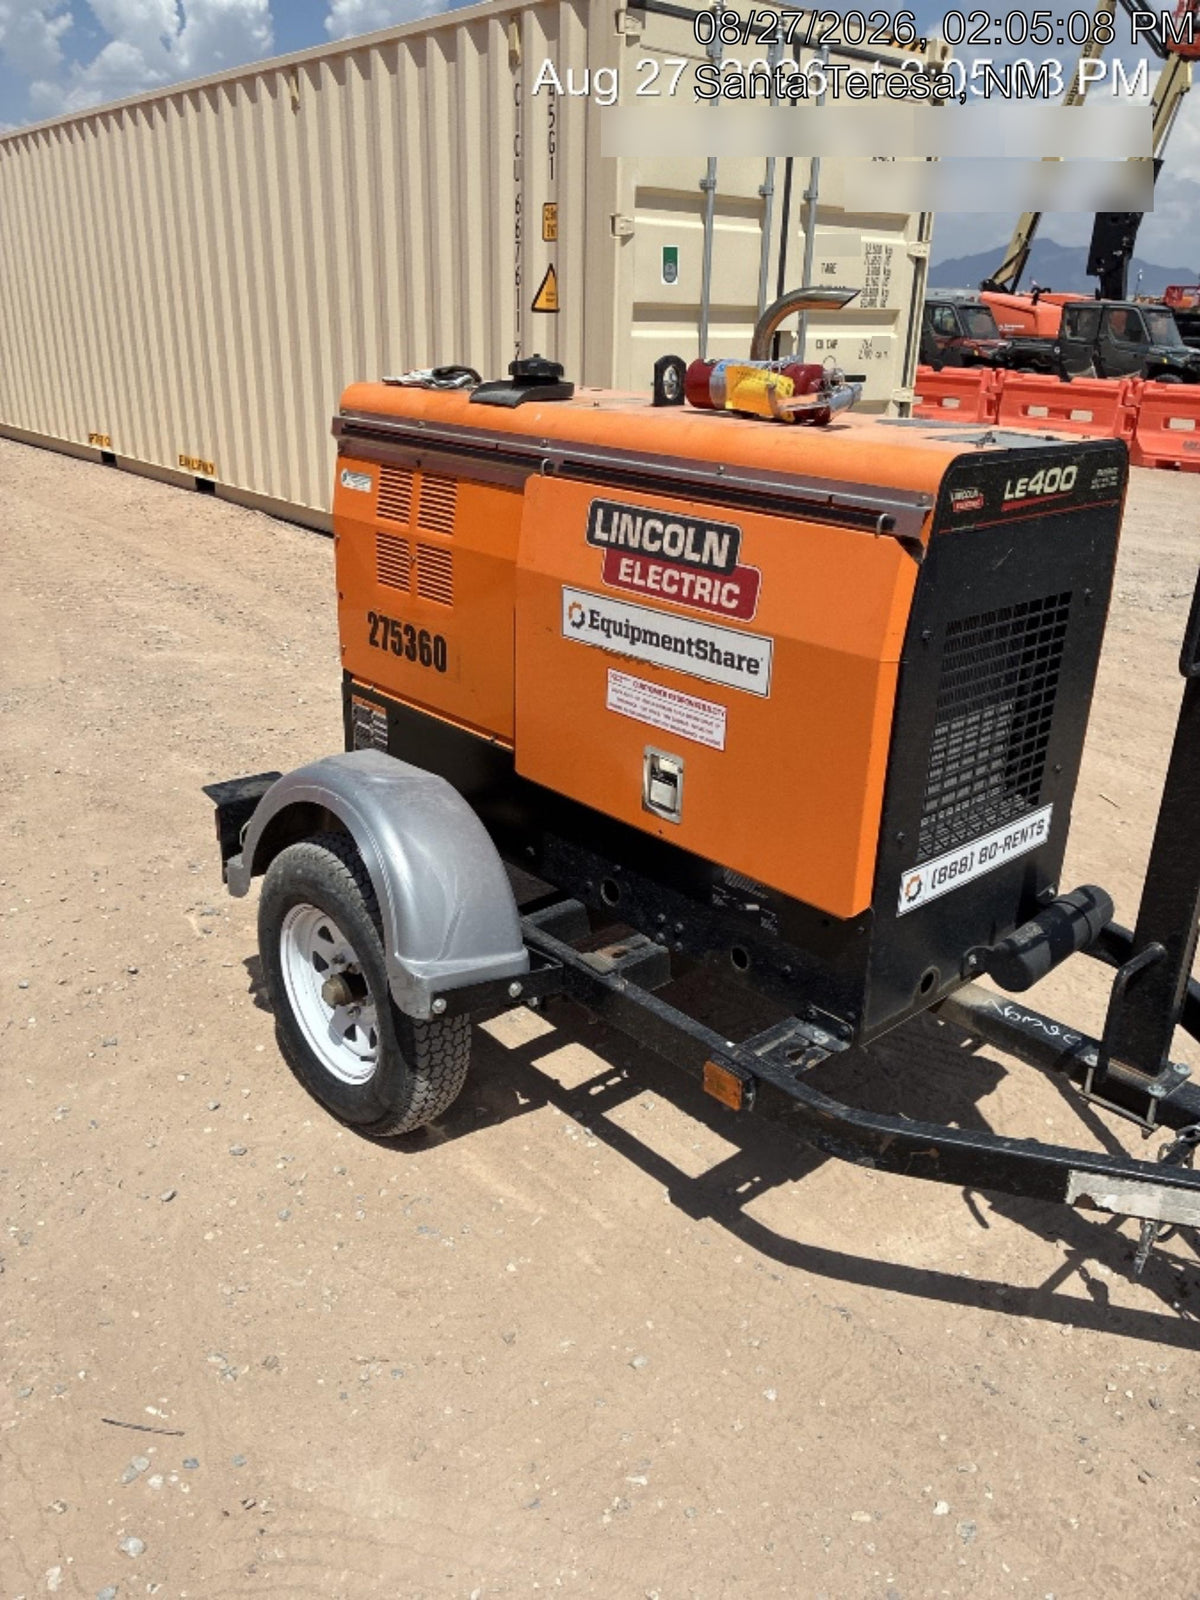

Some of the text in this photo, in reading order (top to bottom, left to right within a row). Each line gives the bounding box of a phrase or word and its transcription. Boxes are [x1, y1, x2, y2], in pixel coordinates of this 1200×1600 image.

[1003, 465, 1079, 500] LE400
[593, 508, 731, 569] LINCOLN
[618, 557, 741, 610] ELECTRIC
[367, 611, 447, 673] 275360
[588, 608, 760, 676] EquipmentShare
[931, 852, 975, 889] (888)
